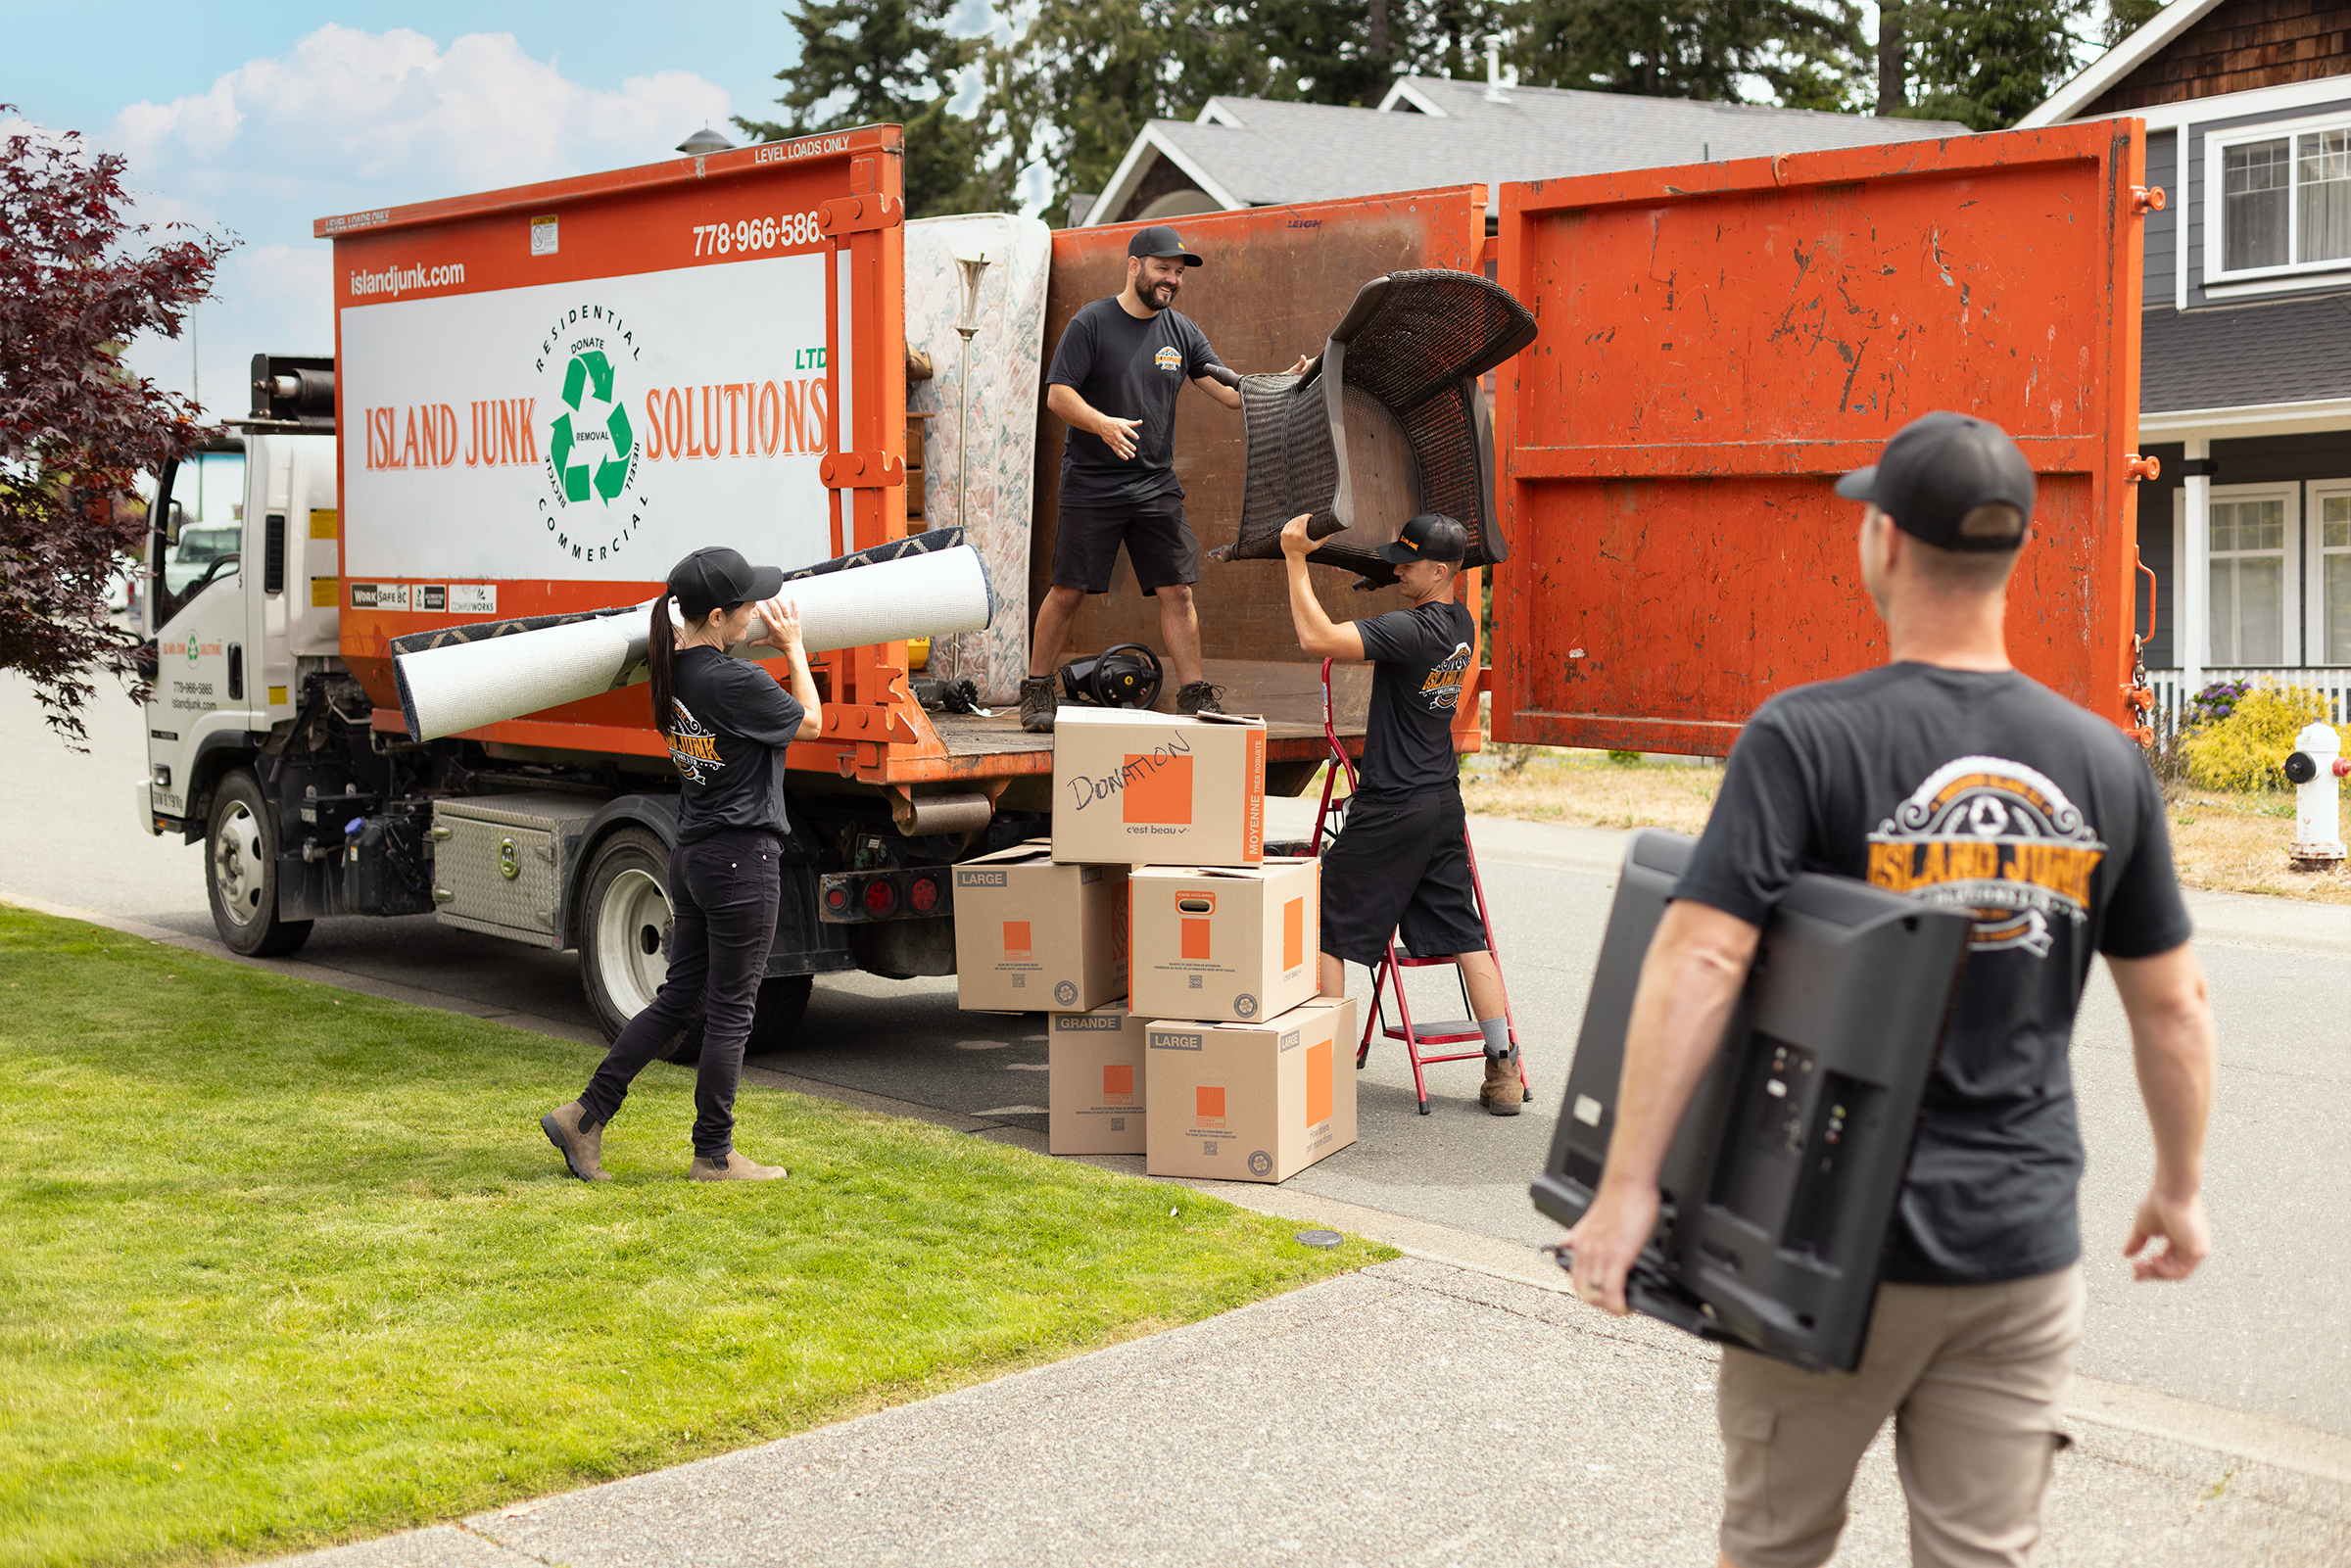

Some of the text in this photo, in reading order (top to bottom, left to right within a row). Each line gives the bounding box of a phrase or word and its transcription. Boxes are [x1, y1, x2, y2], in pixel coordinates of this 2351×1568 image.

[754, 135, 850, 165] LEVEL LOADS ONLY
[325, 210, 390, 232] LEVEL LOADS ONLY
[351, 261, 465, 298] islandjunk.com
[536, 305, 640, 373] RESIDENTIAL
[570, 337, 605, 355] DONATE
[364, 377, 829, 472] ISLAND JUNK SOLUTIONS
[576, 431, 609, 441] REMOVAL
[624, 442, 640, 491] RESELL
[545, 453, 567, 508] RECYCLE
[539, 496, 648, 562] COMMERCIAL
[679, 736, 723, 761] JUNK
[1067, 730, 1190, 811] DONATION
[1127, 825, 1176, 834] c'est beau
[1249, 795, 1260, 855] MOYENNE
[961, 874, 1003, 885] LARGE
[1082, 868, 1101, 881] LARGE
[1866, 841, 2105, 909] ISLAND JUNK
[1060, 1018, 1117, 1029] GRANDE
[1155, 1035, 1198, 1048] LARGE
[1281, 1032, 1299, 1049] LARGE
